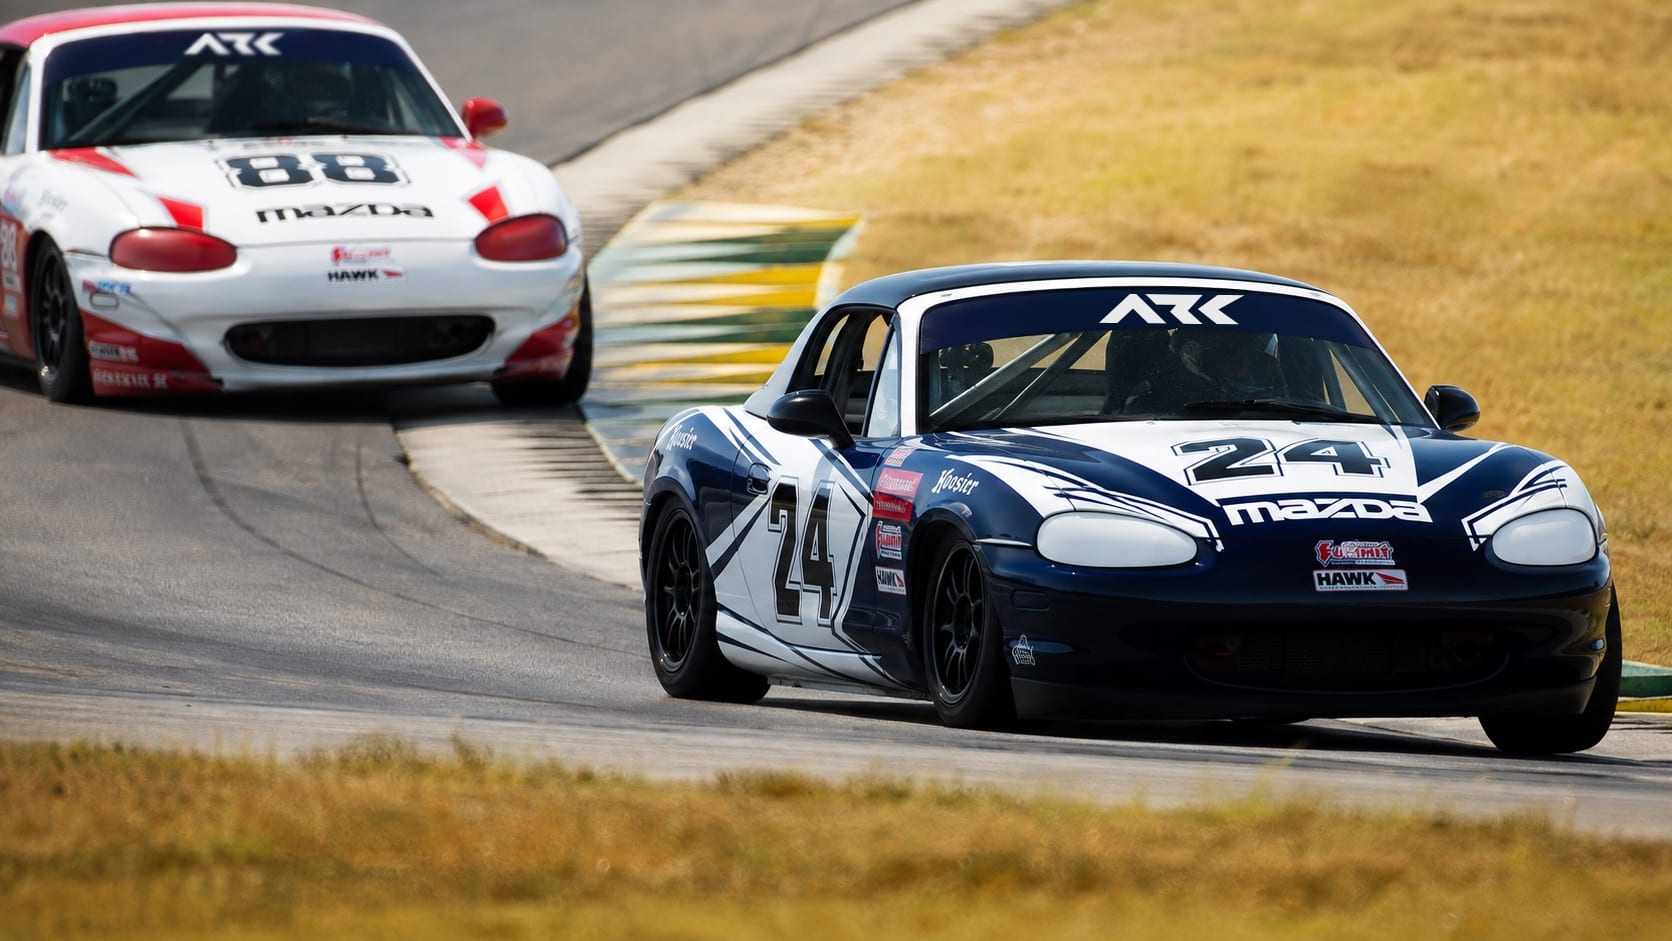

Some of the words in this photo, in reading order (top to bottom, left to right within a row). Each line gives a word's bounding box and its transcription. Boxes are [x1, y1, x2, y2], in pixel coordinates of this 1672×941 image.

[185, 31, 284, 55] ARK
[217, 152, 410, 190] 88
[256, 203, 436, 223] mazda
[327, 268, 379, 283] HAWK
[1100, 293, 1245, 325] ARK
[1171, 437, 1391, 485] 24
[931, 467, 979, 494] Hoosier
[1223, 497, 1433, 526] mazda
[767, 475, 837, 628] 24
[877, 569, 898, 588] HAWK
[1316, 572, 1377, 586] HAWK
